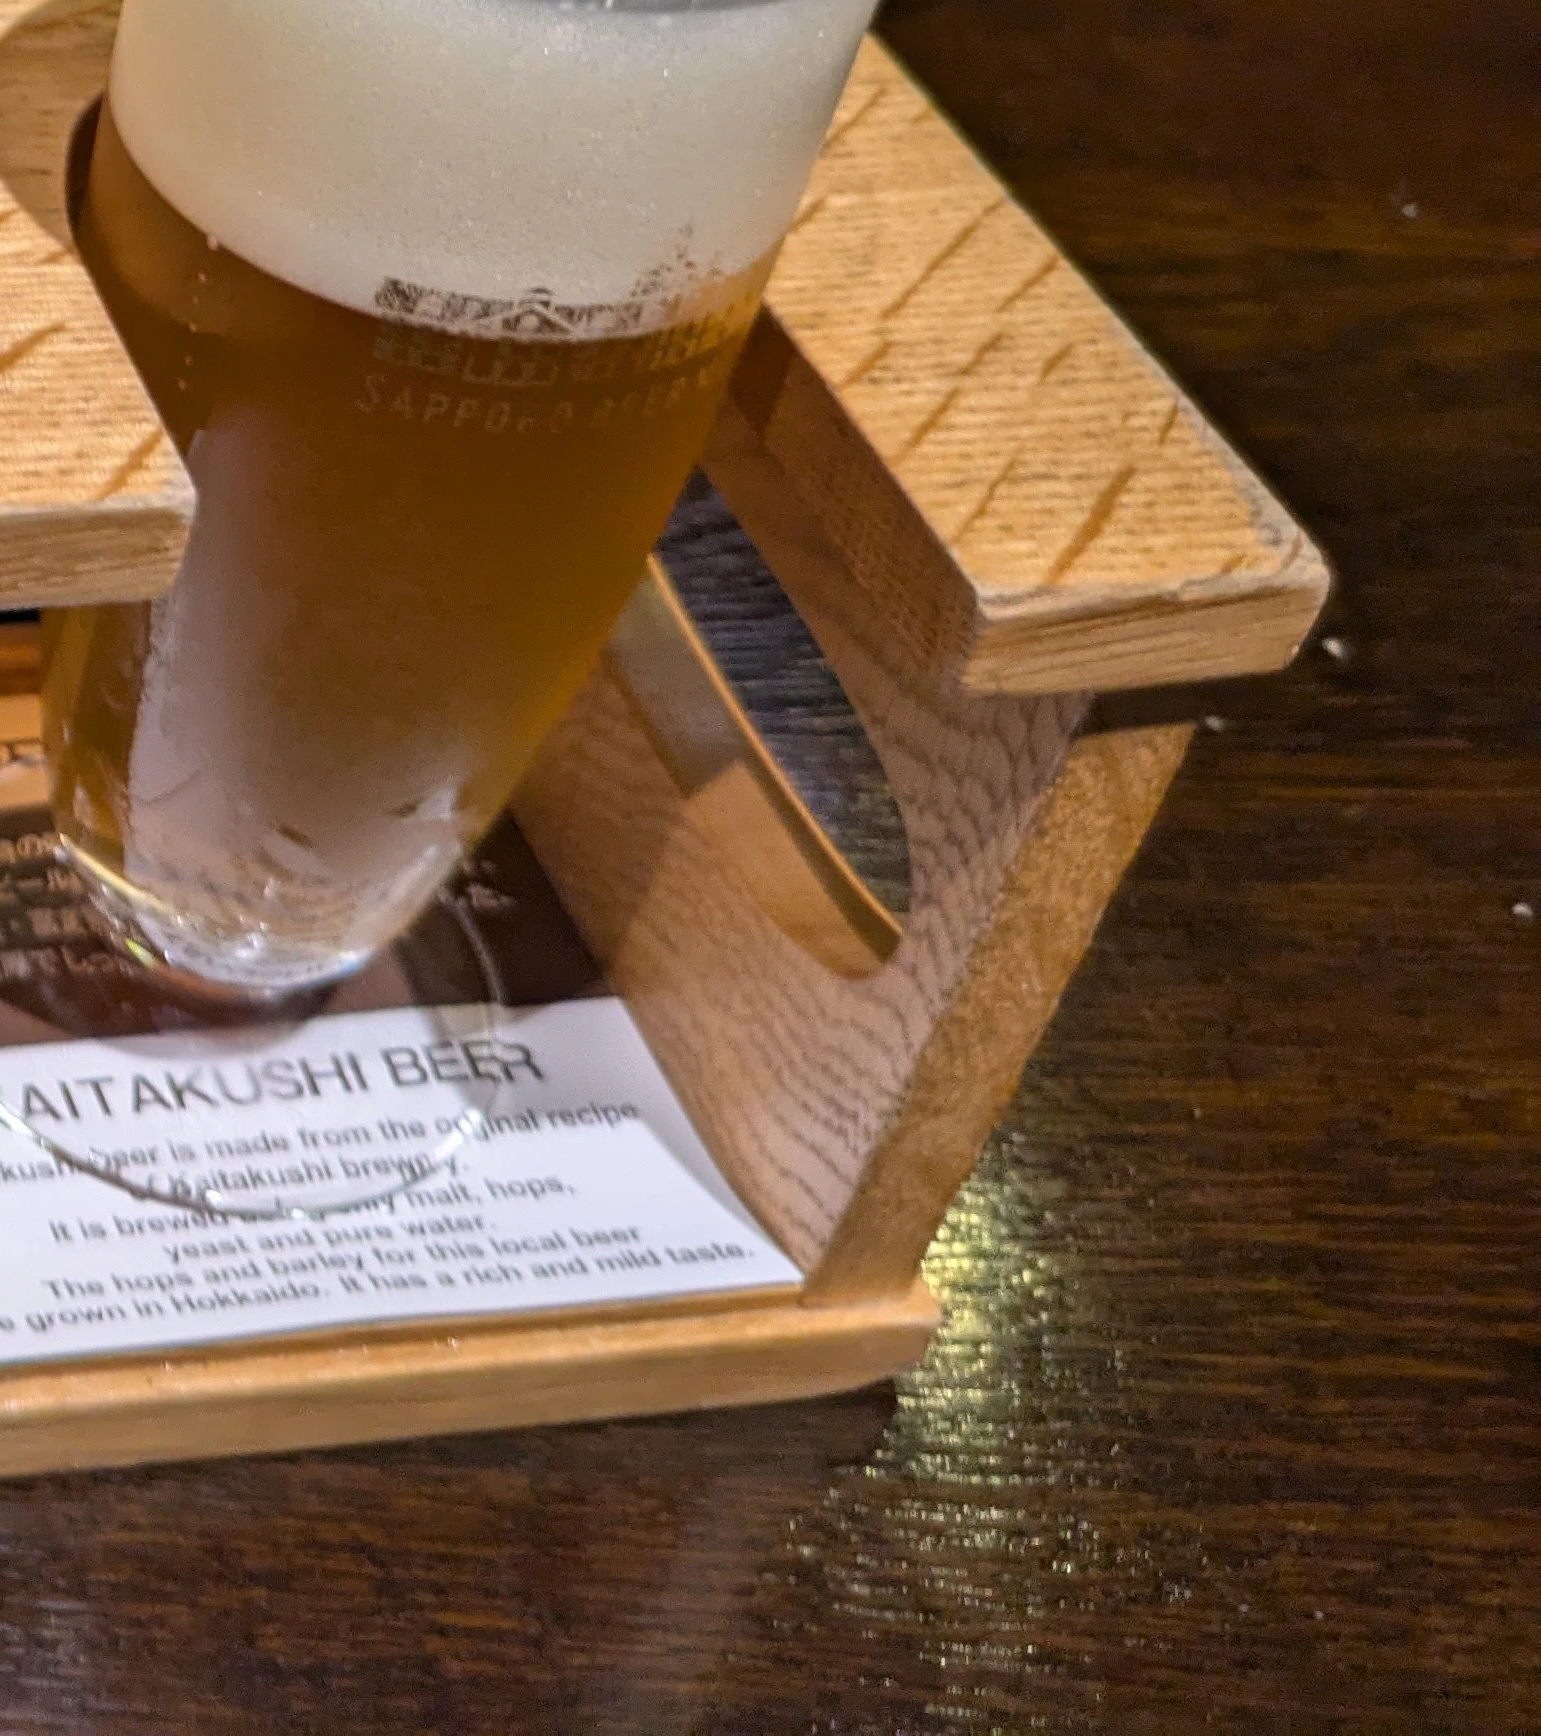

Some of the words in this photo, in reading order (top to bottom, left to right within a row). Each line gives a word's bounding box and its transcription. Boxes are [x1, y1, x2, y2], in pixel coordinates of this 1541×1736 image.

[381, 1038, 548, 1088] BEER
[168, 1137, 197, 1162] is
[204, 1130, 291, 1158] made
[297, 1125, 372, 1150] from
[376, 1115, 426, 1141] the
[434, 1107, 541, 1144] oginal
[546, 1101, 639, 1132] recipe
[338, 1150, 469, 1185] brewy.
[49, 1218, 73, 1243] It
[80, 1217, 108, 1241] is
[403, 1181, 483, 1208] malt,
[486, 1175, 575, 1202] hops,
[161, 1236, 250, 1264] yeast
[256, 1226, 313, 1251] and
[322, 1222, 394, 1248] pure
[401, 1214, 497, 1238] water.
[25, 1302, 127, 1334] grown
[132, 1298, 166, 1318] in
[169, 1280, 330, 1315] Hokkaido.
[339, 1270, 363, 1296] It
[369, 1263, 428, 1292] has
[437, 1269, 456, 1288] a
[462, 1260, 523, 1287] rich
[529, 1252, 591, 1281] and
[594, 1246, 664, 1276] mild
[668, 1239, 755, 1267] taste.
[40, 1276, 105, 1301] The
[110, 1270, 194, 1296] hops
[201, 1259, 262, 1284] and
[266, 1248, 365, 1277] barley
[371, 1244, 418, 1268] for
[425, 1234, 486, 1263] this
[492, 1227, 568, 1257] local
[575, 1224, 644, 1248] beer
